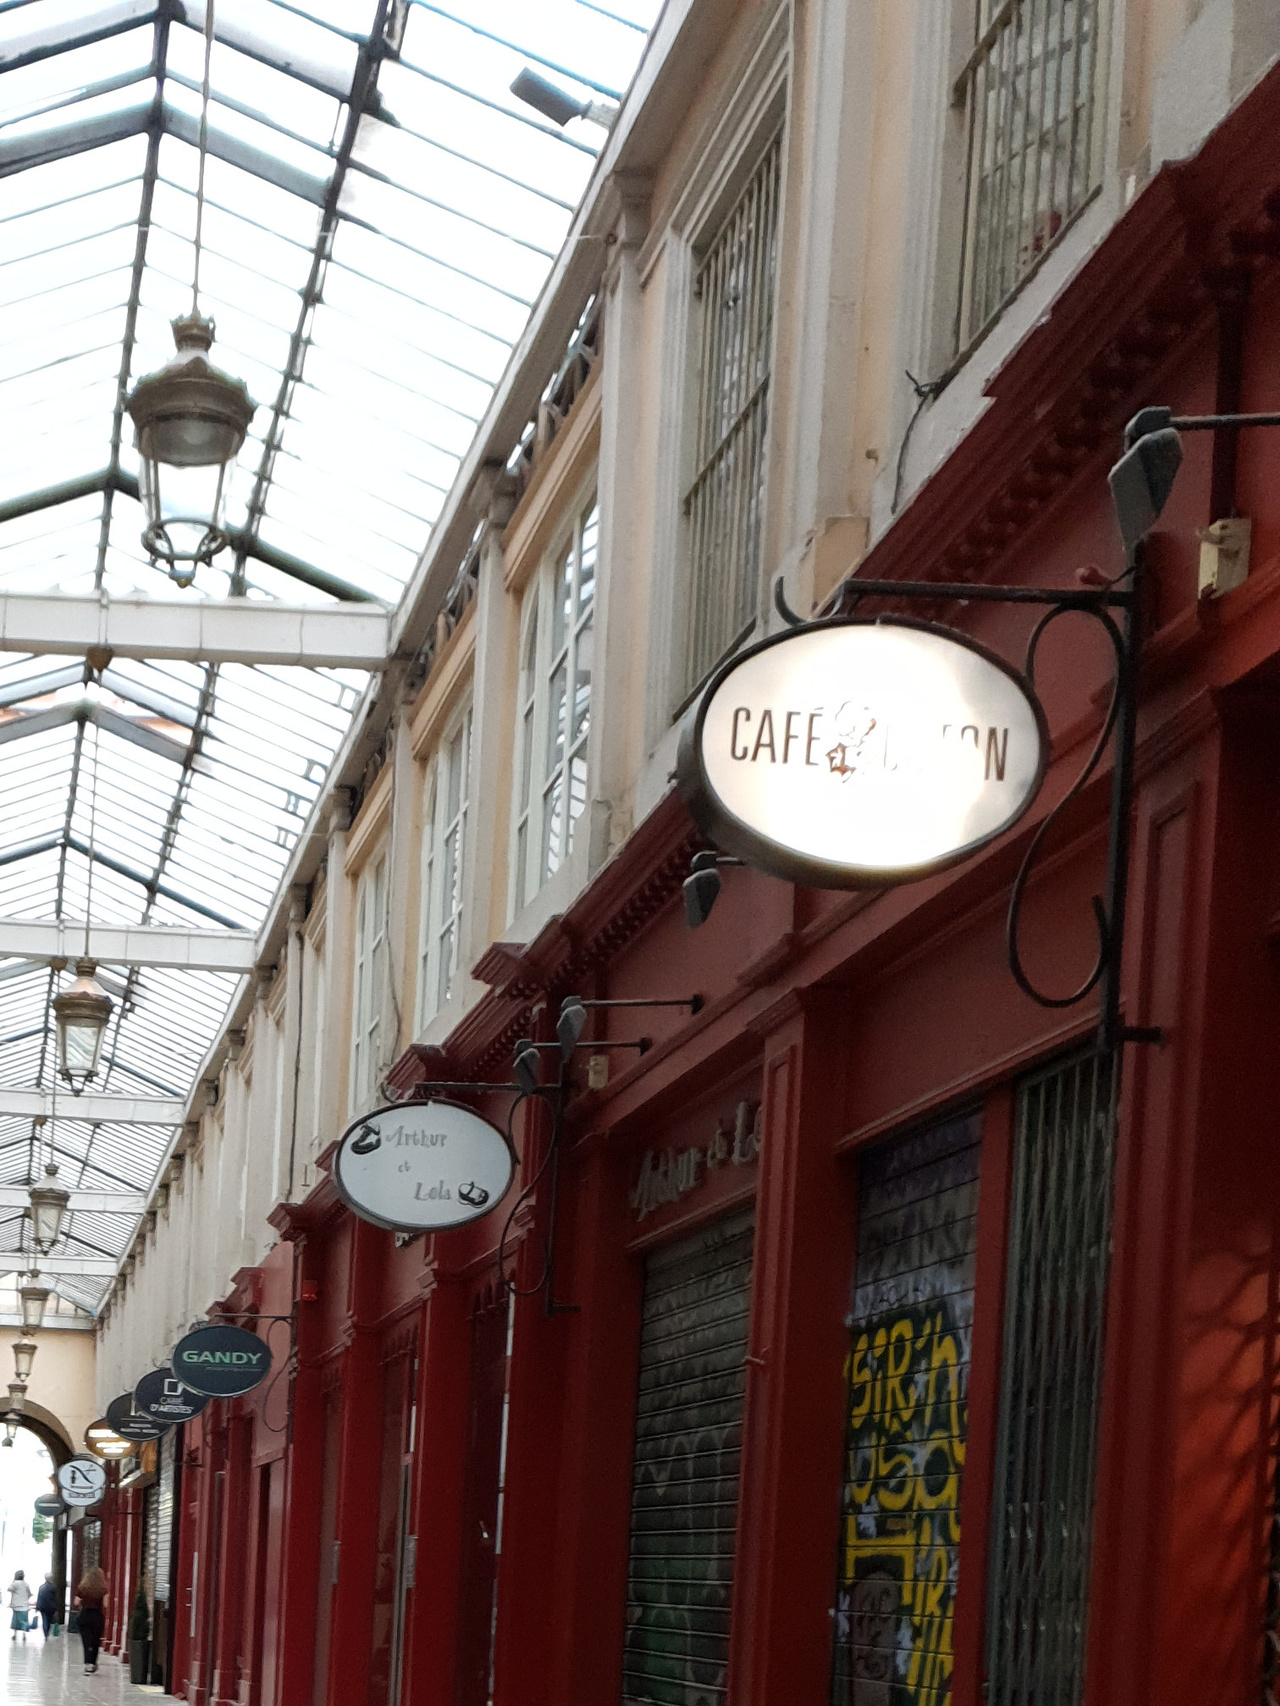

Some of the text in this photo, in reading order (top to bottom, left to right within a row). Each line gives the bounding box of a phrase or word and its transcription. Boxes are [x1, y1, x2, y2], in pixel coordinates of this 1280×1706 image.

[385, 1125, 448, 1147] Arthur
[414, 1180, 451, 1201] Lola
[182, 1350, 263, 1365] GANDY
